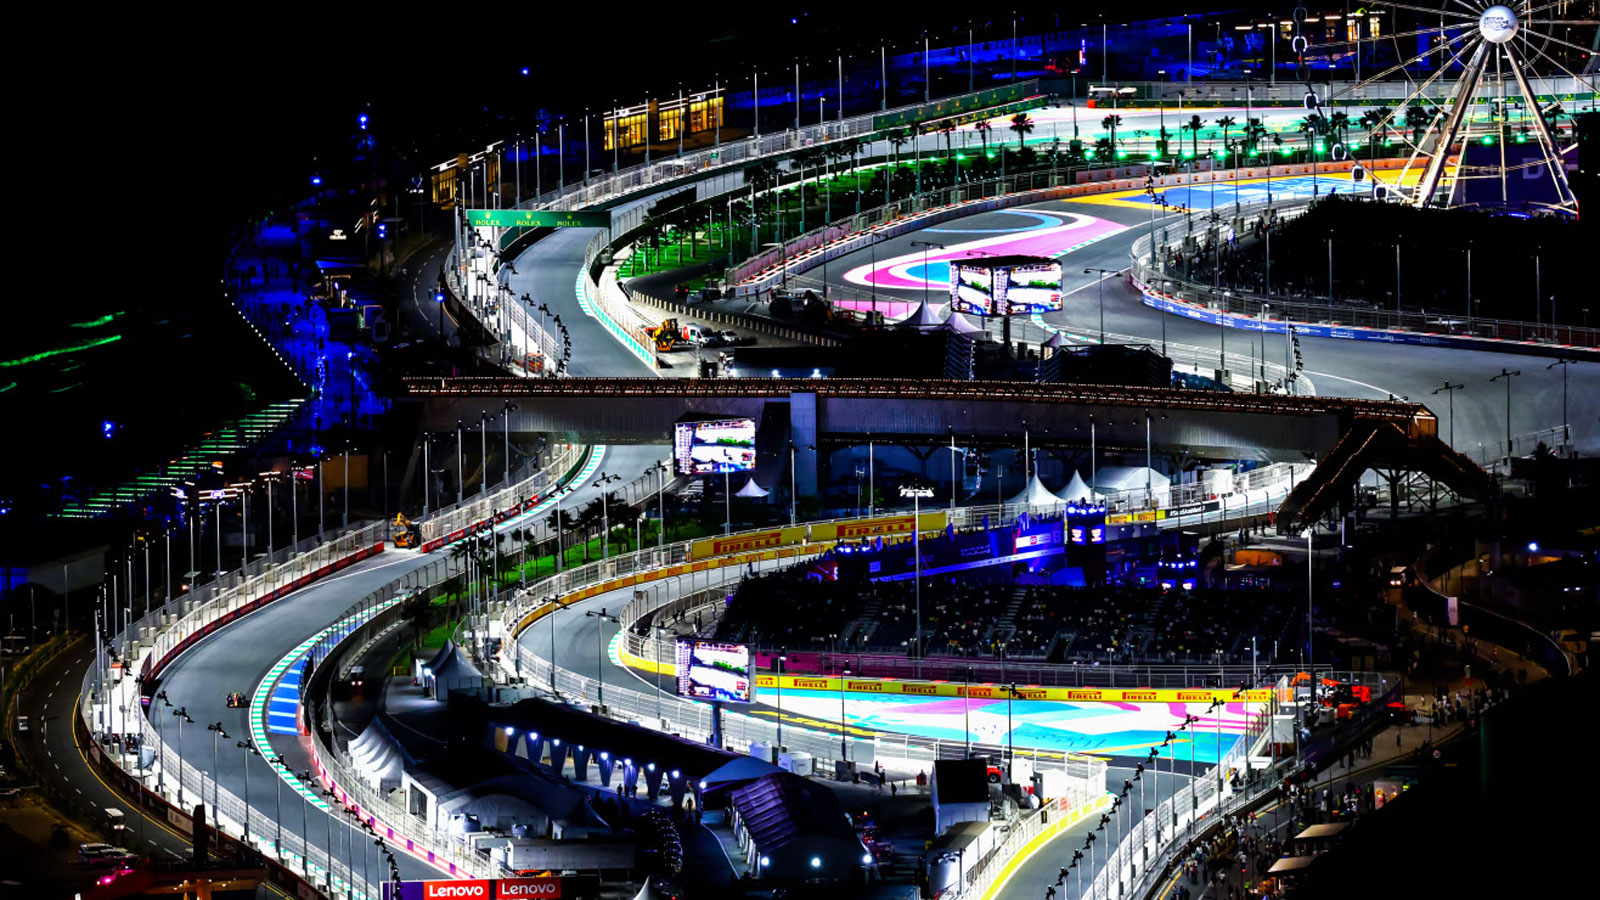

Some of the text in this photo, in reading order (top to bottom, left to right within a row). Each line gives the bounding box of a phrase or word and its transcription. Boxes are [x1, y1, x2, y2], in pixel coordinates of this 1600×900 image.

[713, 532, 782, 554] PIRELLI
[793, 678, 828, 689] PIRELLI
[847, 681, 883, 692] PIRELLI
[902, 683, 937, 694] PIRELLI
[1067, 690, 1102, 700] PIRELLI
[1122, 691, 1157, 700] PIRELLI
[1176, 692, 1212, 701] PIRELLI
[428, 883, 484, 898] Lenovo
[501, 882, 556, 896] Lenovo
